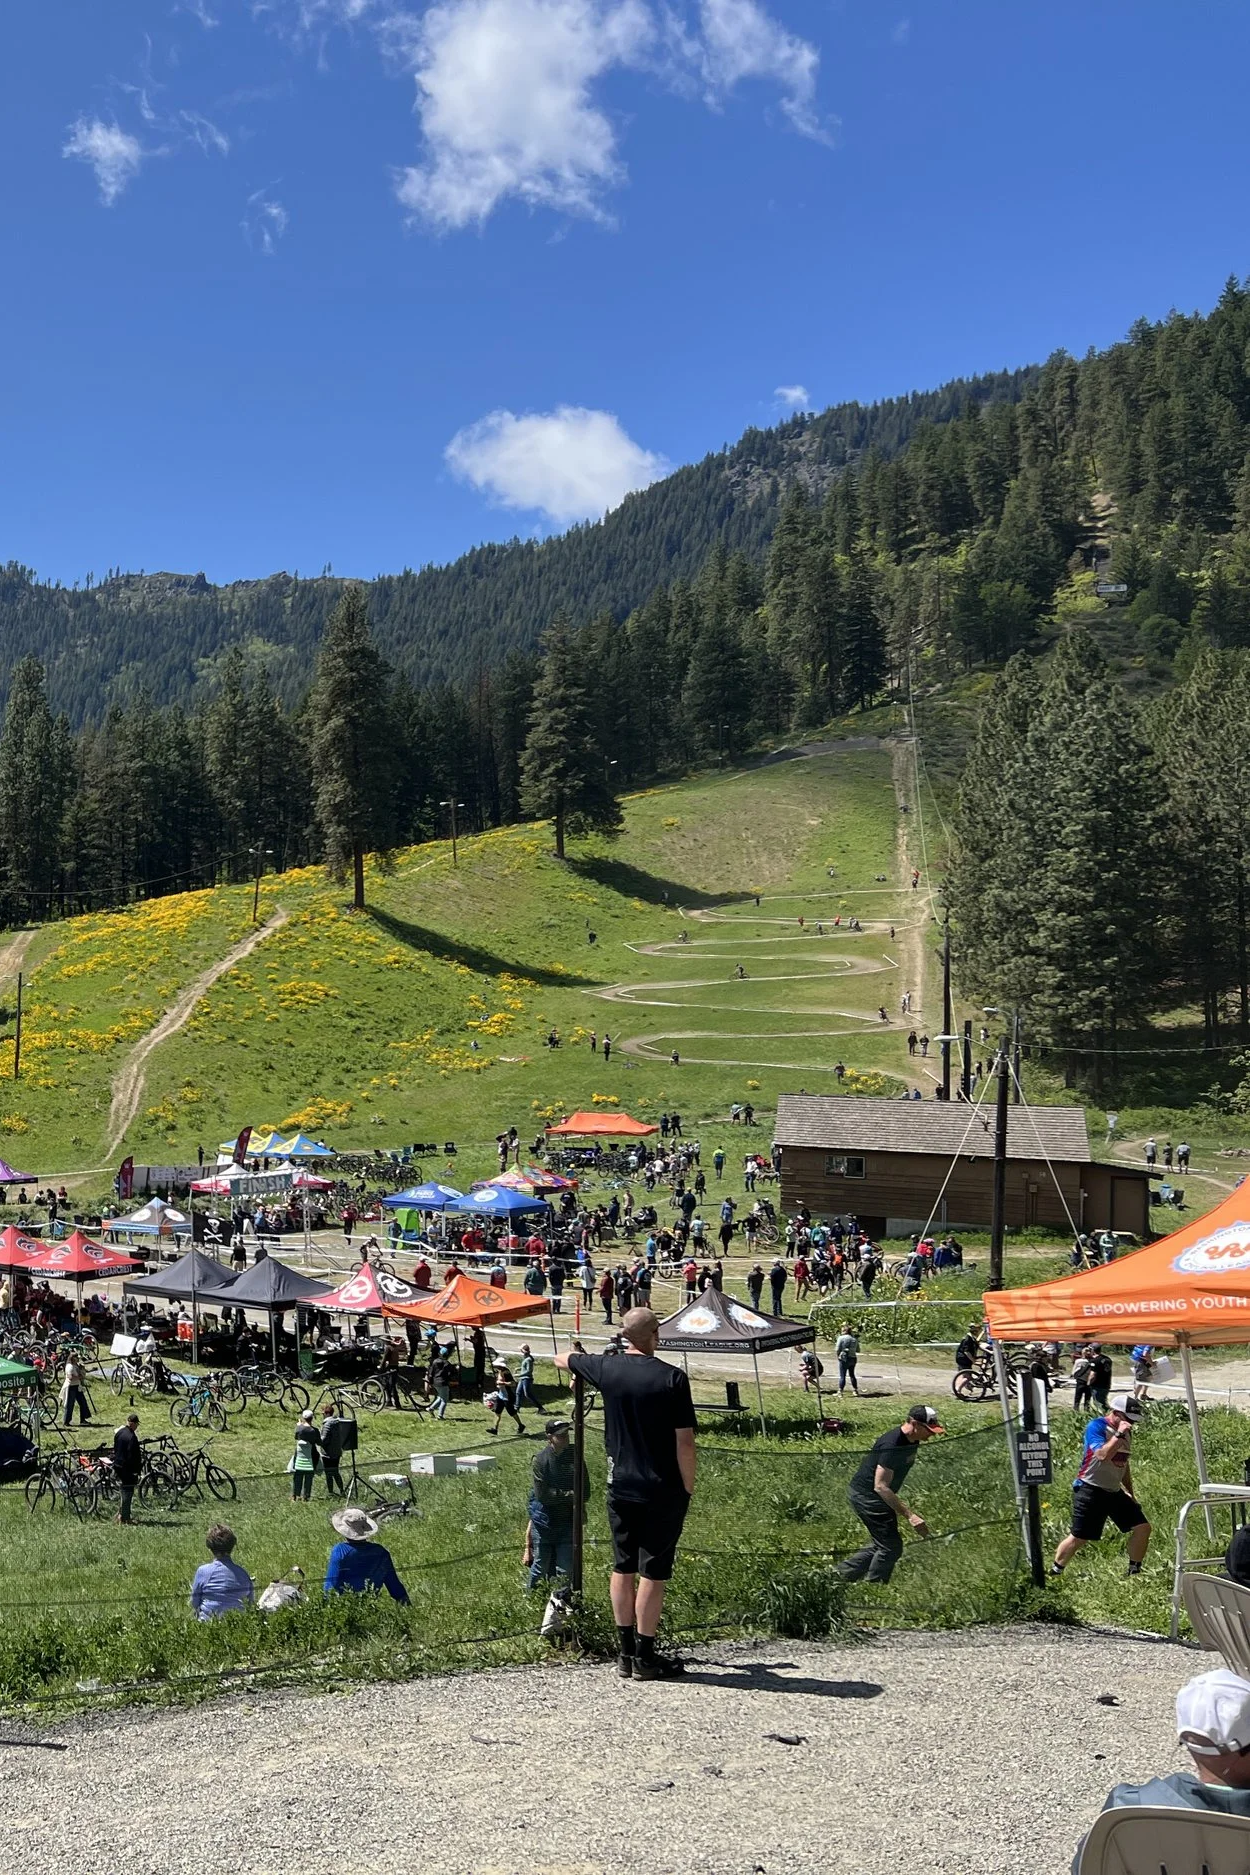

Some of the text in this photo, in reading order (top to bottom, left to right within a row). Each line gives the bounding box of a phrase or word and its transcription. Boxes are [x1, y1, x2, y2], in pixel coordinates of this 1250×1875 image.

[239, 1175, 285, 1194] FINISH
[1083, 1296, 1248, 1316] EMPOWERING YOUTH
[1028, 1433, 1040, 1442] NO
[1027, 1460, 1043, 1468] THIS
[1026, 1468, 1046, 1476] POINT
